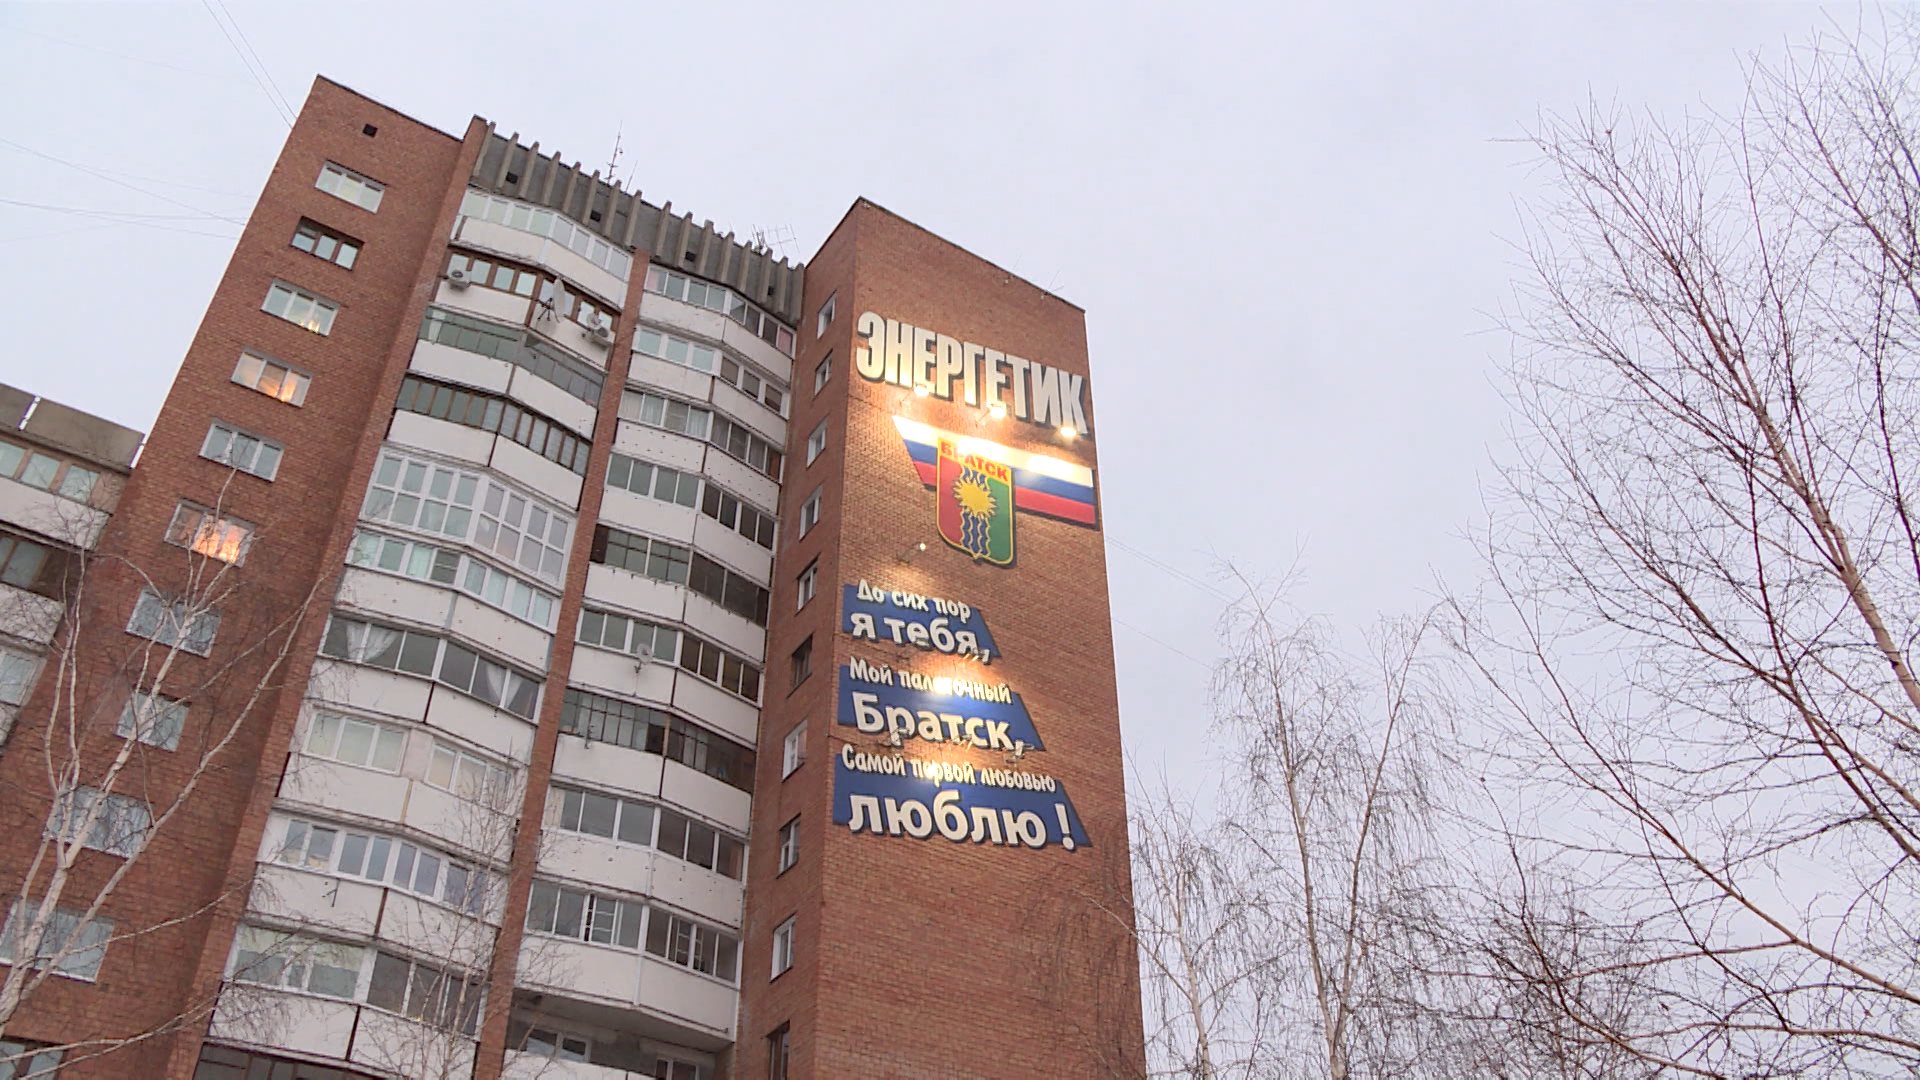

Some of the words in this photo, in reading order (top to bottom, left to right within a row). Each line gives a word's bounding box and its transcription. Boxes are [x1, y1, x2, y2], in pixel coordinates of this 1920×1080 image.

[856, 311, 1089, 436] ЭНЕРГЕТИК
[857, 579, 885, 603] До
[891, 591, 929, 612] сих
[934, 598, 971, 623] пор
[883, 618, 991, 665] тебя,
[850, 656, 893, 686] Мой
[899, 669, 1012, 704] палочный
[852, 692, 1024, 757] Братск,
[842, 743, 905, 777] Самой
[981, 769, 1056, 793] любовью
